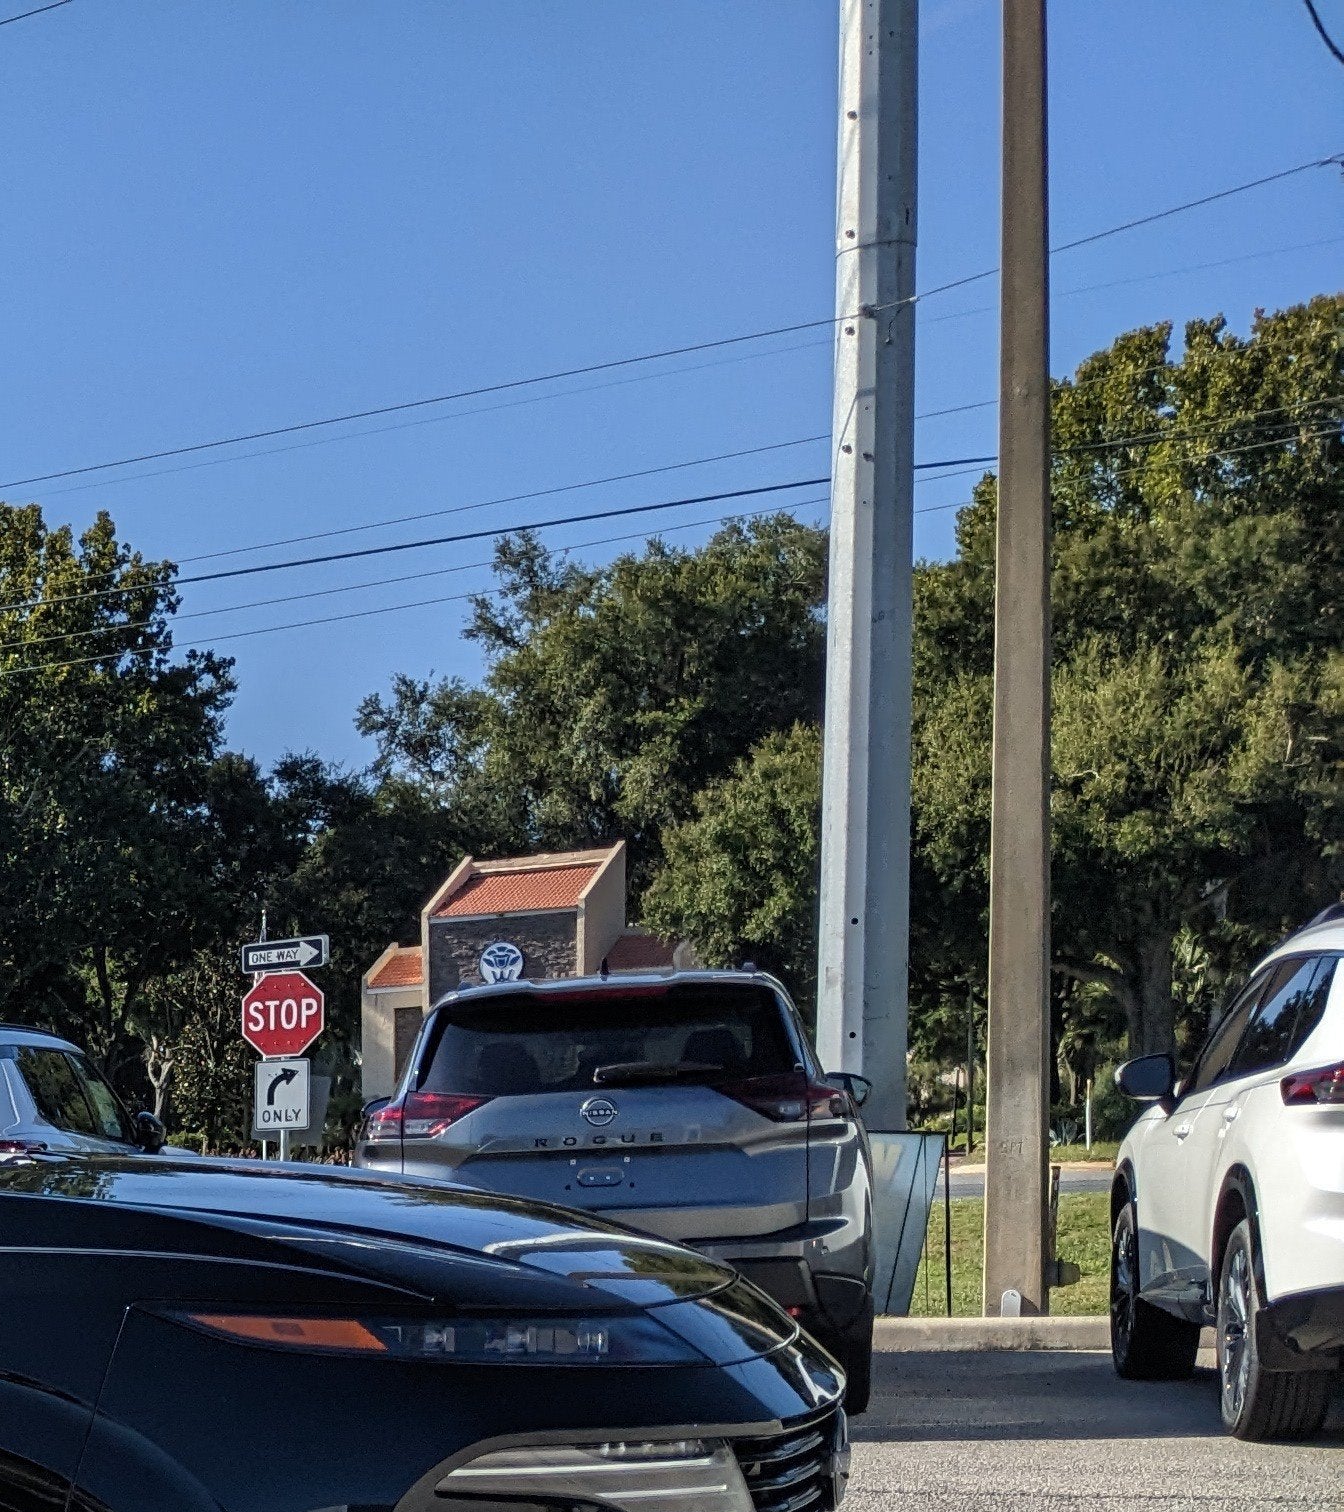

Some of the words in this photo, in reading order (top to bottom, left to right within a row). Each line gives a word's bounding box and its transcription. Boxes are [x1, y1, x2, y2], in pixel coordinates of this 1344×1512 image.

[251, 951, 273, 964] ONE
[276, 949, 299, 962] WAY
[248, 997, 318, 1032] STOP
[262, 1108, 302, 1123] ONLY
[534, 1131, 664, 1148] ROGUE
